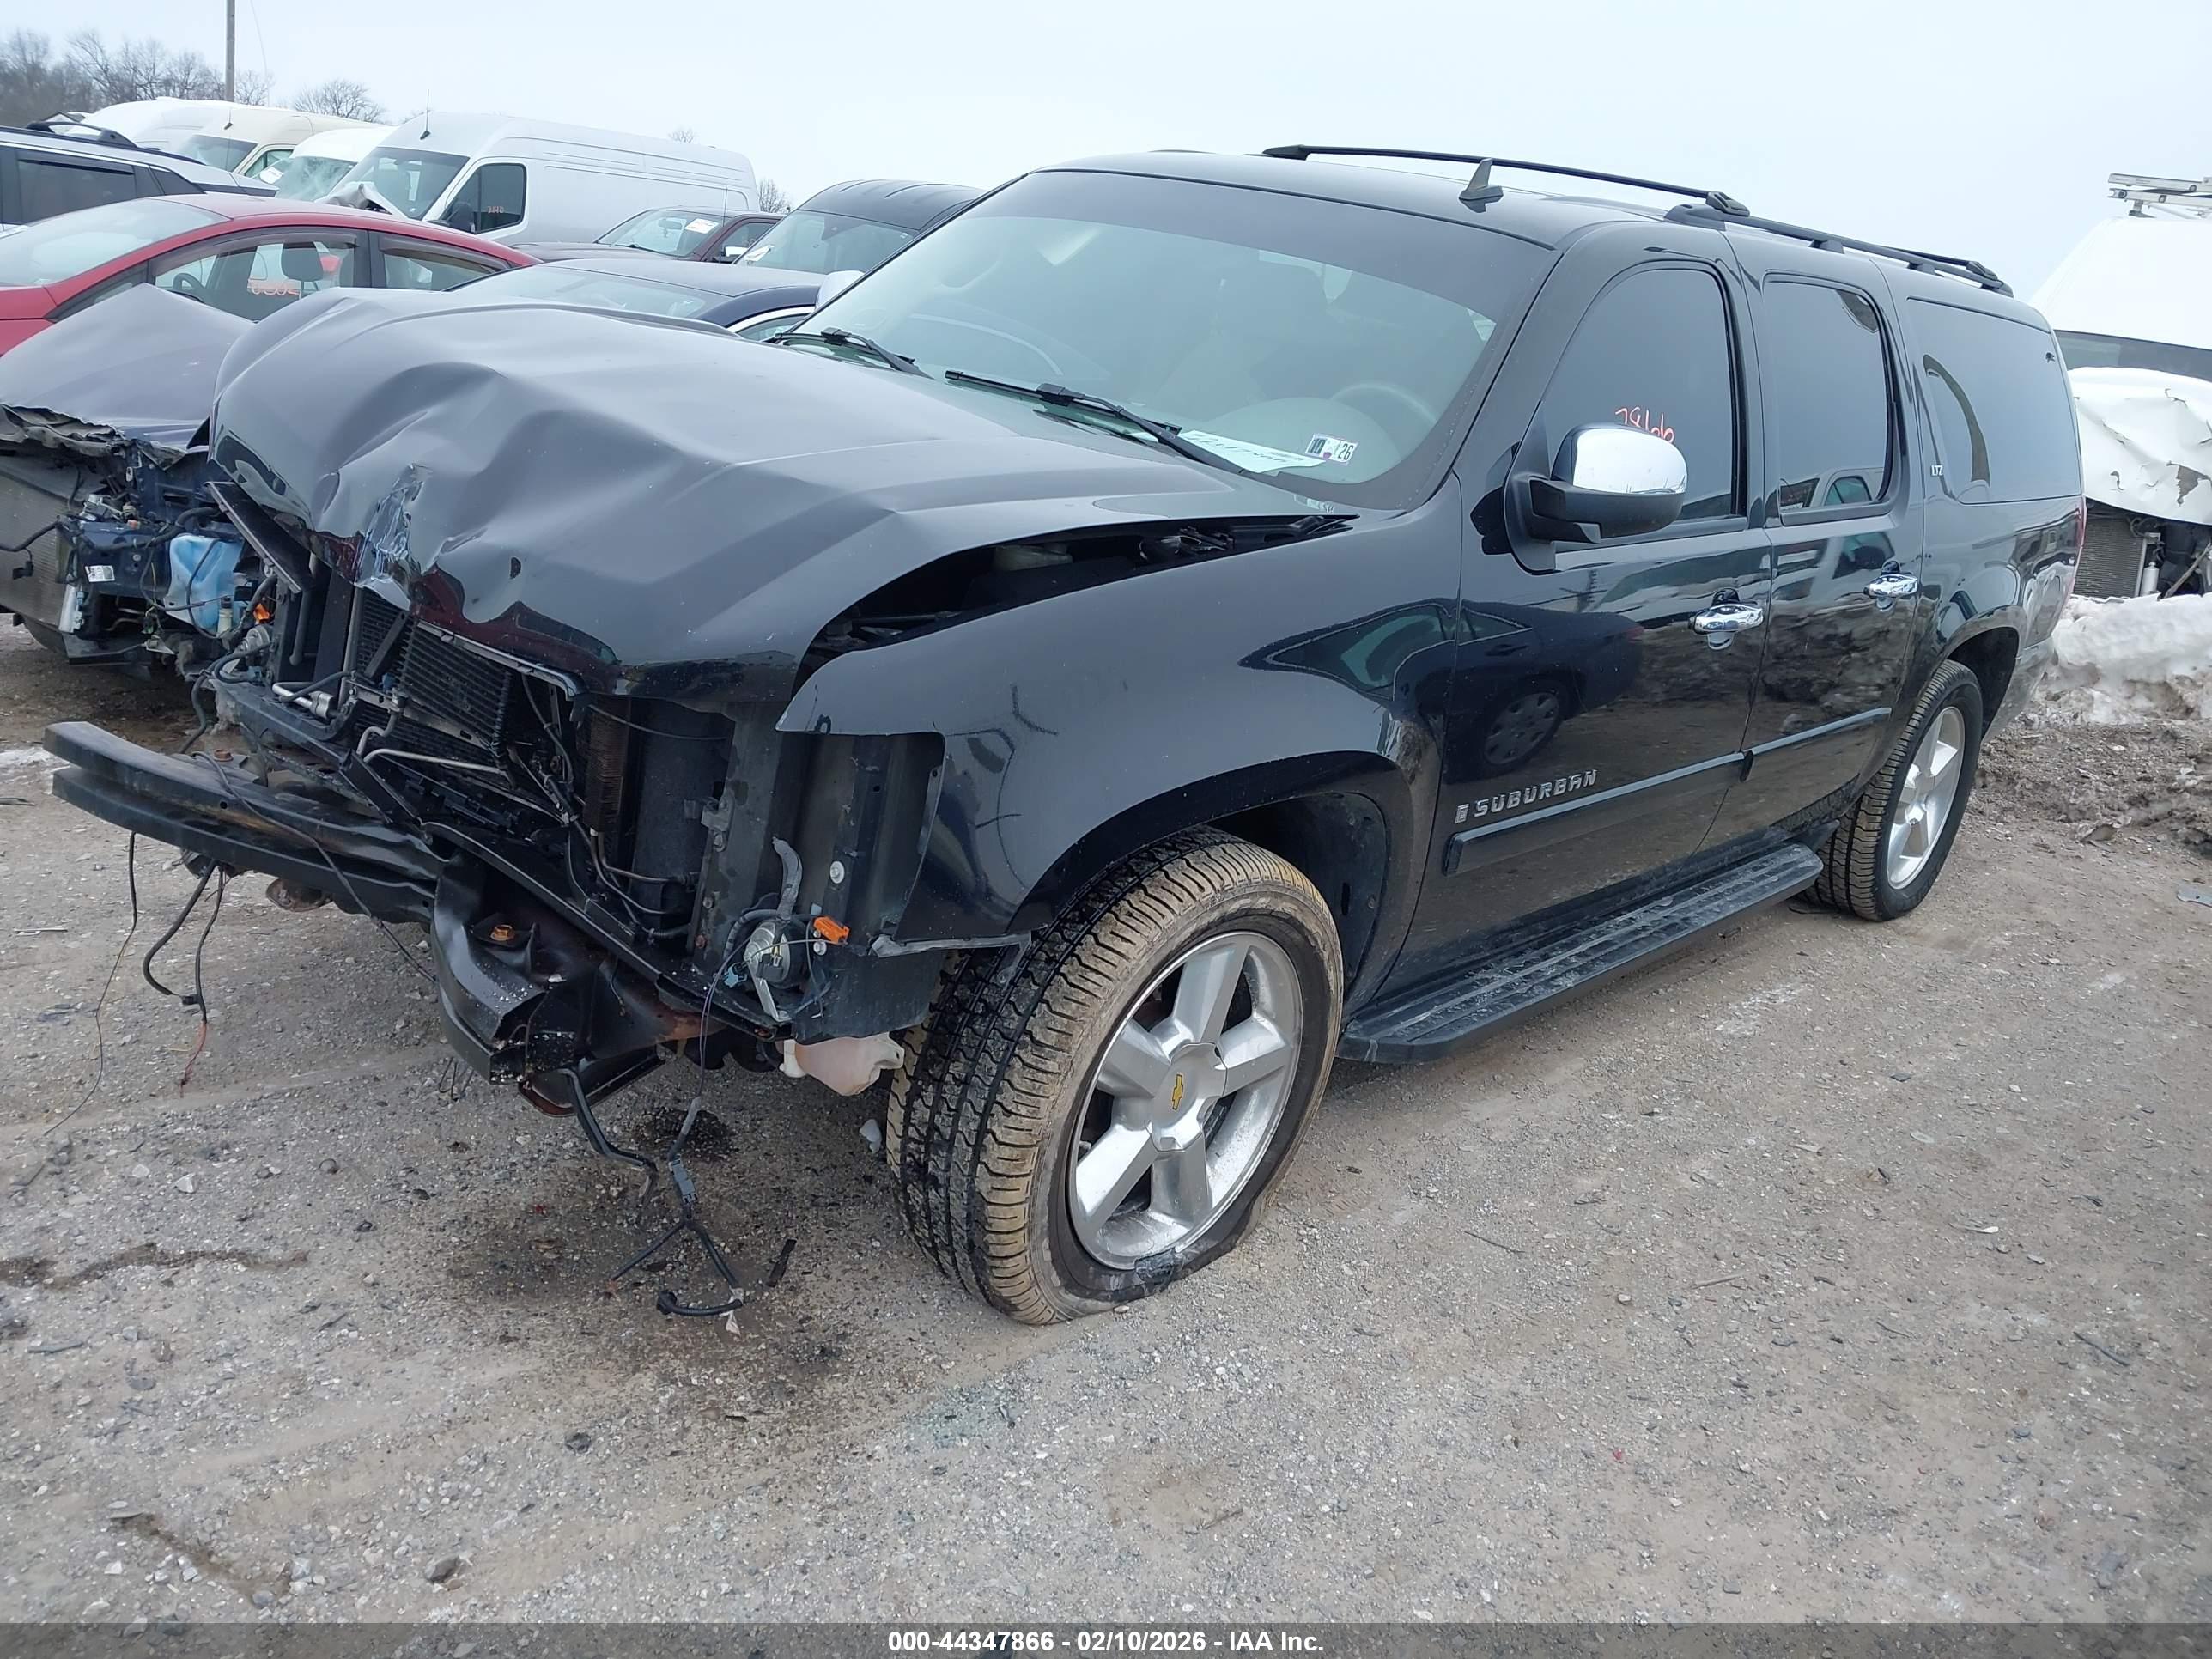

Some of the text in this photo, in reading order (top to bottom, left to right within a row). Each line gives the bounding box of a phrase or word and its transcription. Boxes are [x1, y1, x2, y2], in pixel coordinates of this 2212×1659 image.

[1338, 443, 1354, 460] 26
[1931, 465, 1943, 476] LTZ
[1474, 769, 1598, 817] SUBURBAN
